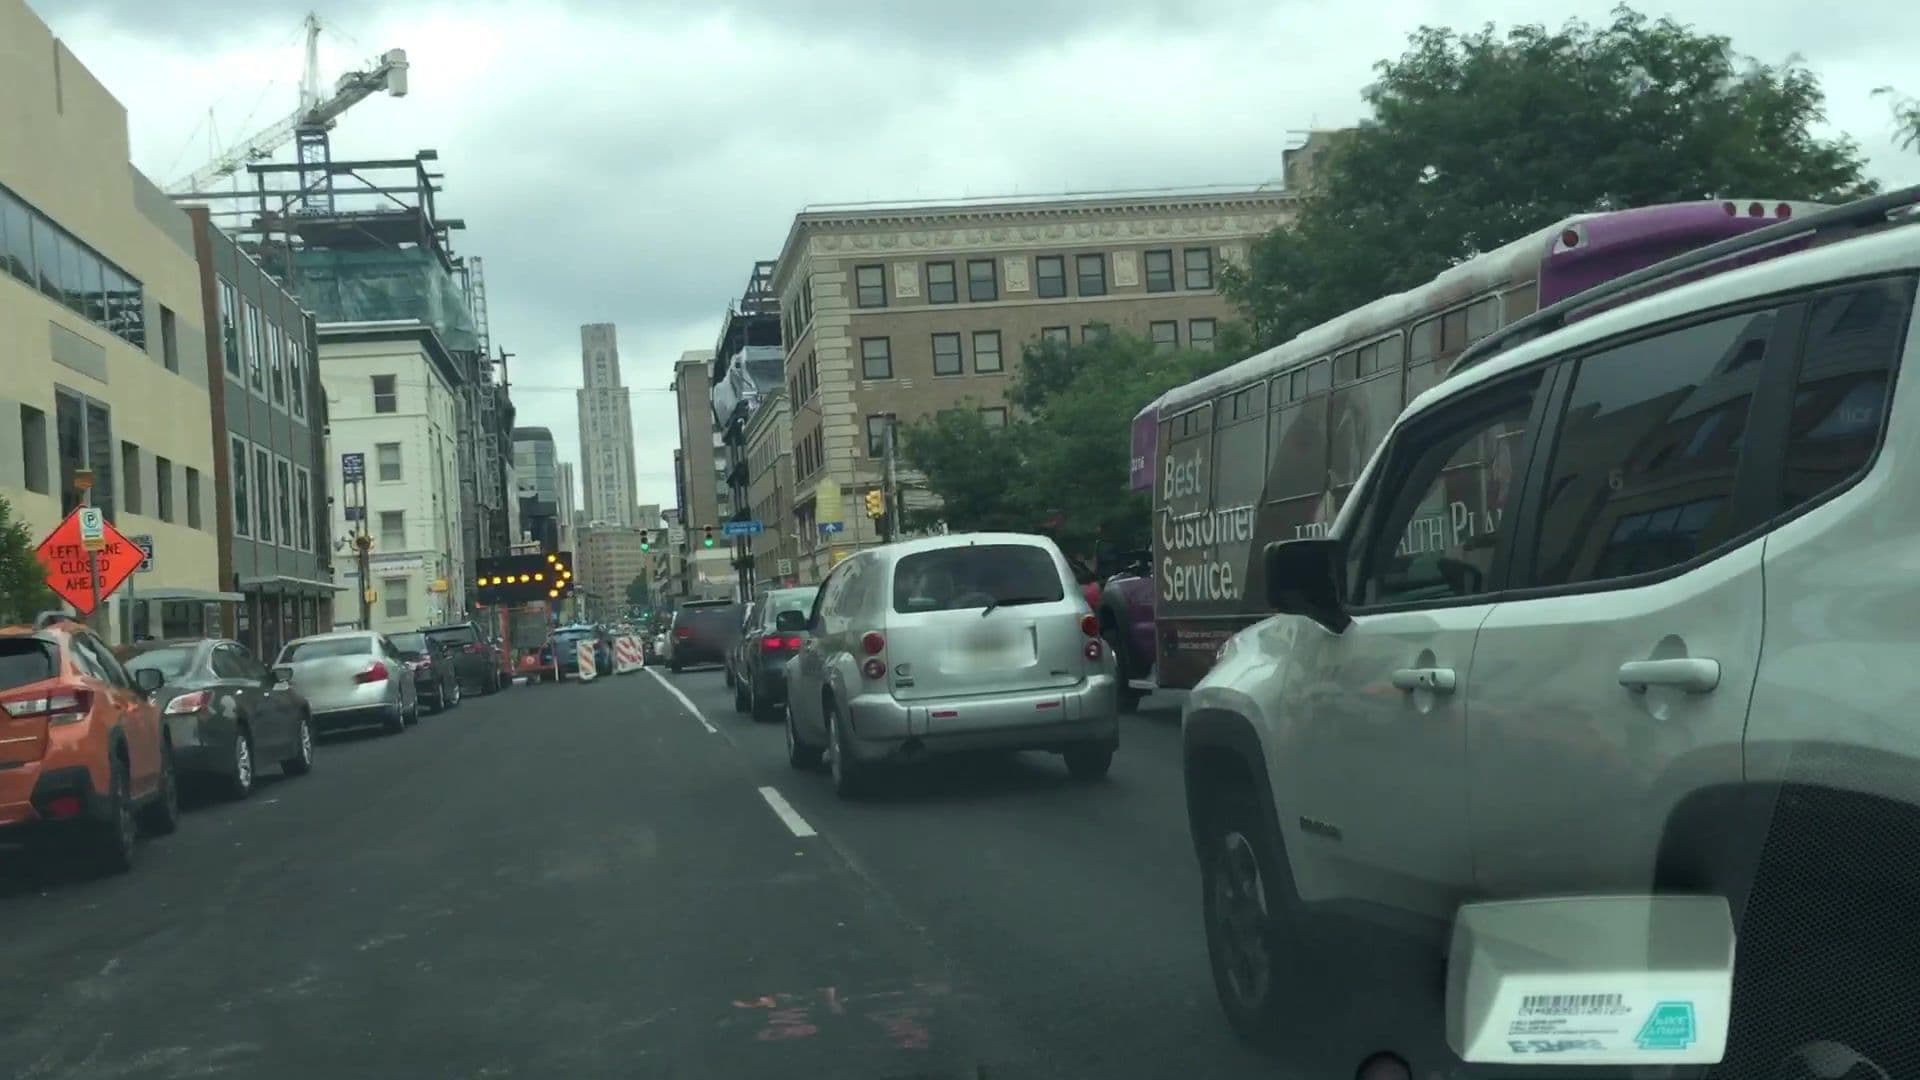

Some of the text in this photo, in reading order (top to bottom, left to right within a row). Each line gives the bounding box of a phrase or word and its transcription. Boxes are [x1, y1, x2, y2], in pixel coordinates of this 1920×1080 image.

[1163, 448, 1201, 500] Best
[1162, 504, 1254, 551] Customer
[49, 545, 82, 559] LEFT
[60, 560, 109, 575] CLOSD
[66, 576, 106, 590] AHED
[1163, 551, 1238, 601] Service.
